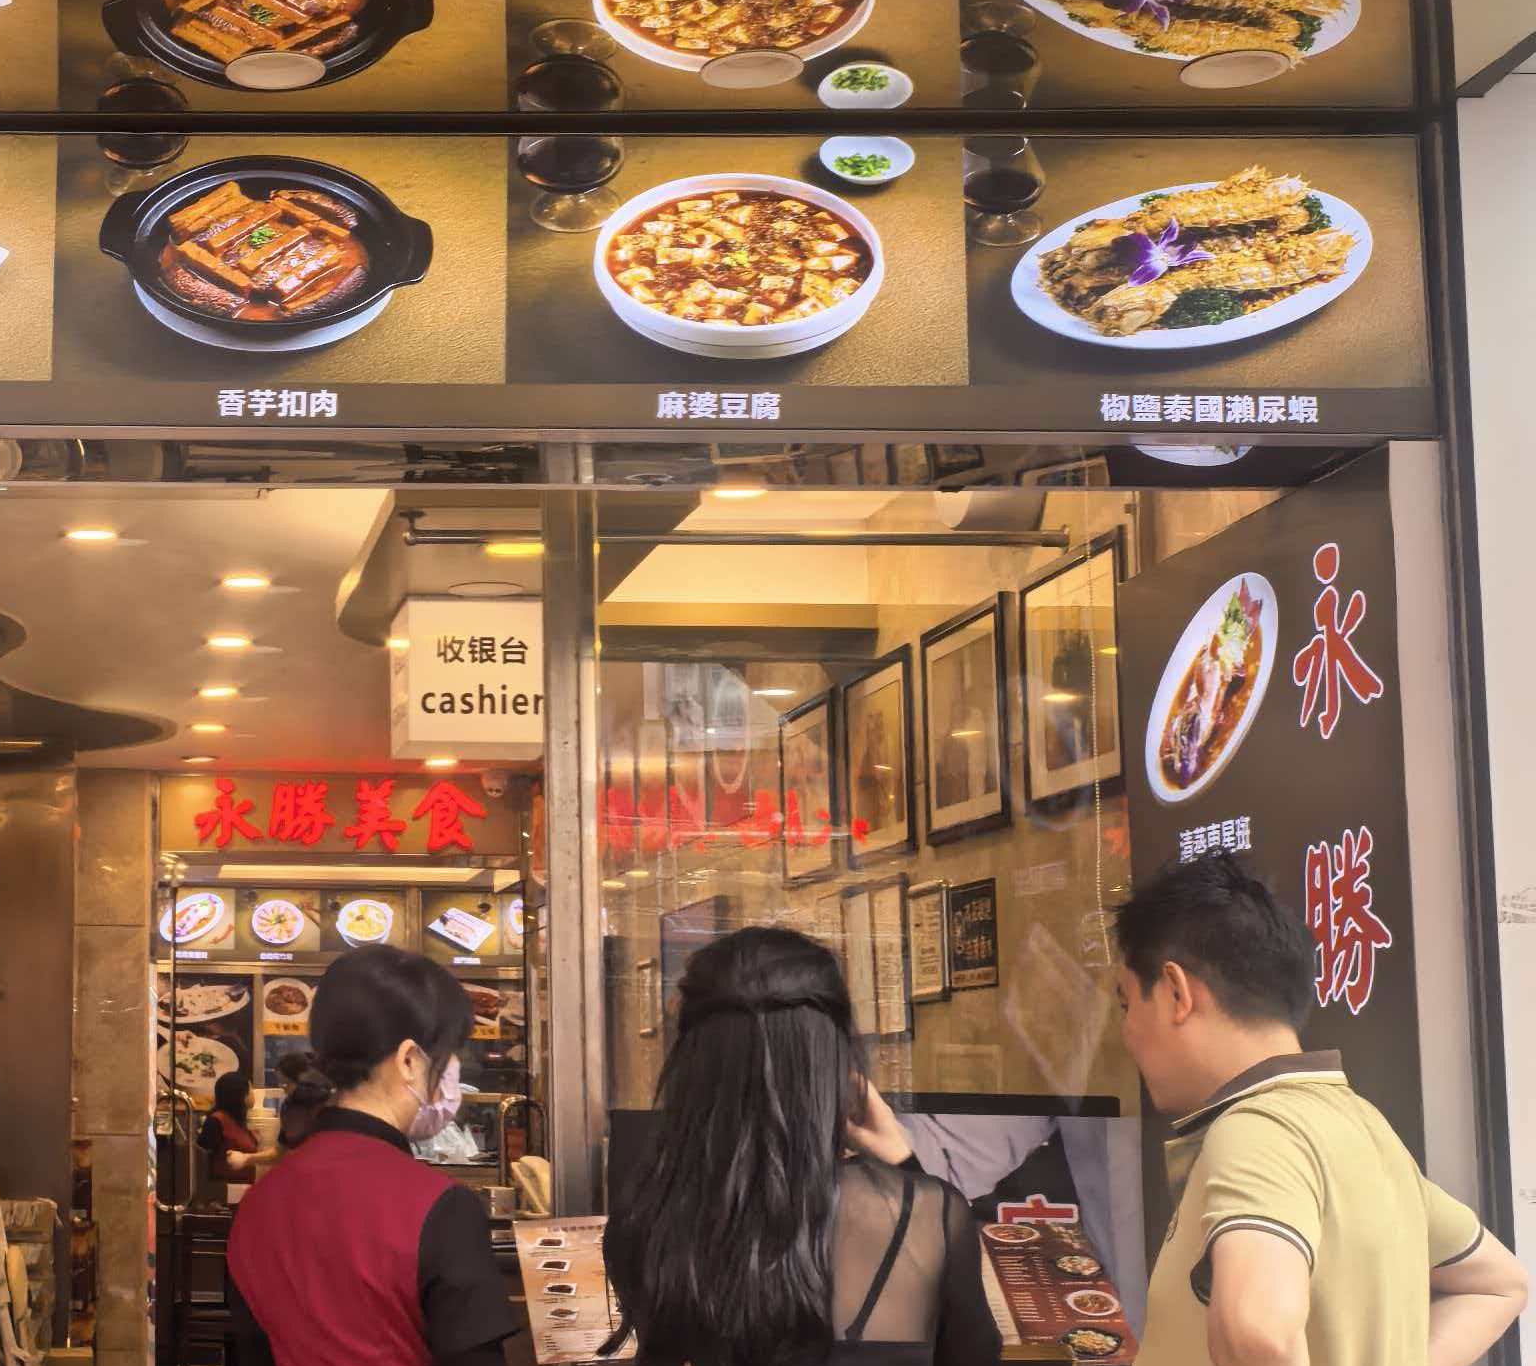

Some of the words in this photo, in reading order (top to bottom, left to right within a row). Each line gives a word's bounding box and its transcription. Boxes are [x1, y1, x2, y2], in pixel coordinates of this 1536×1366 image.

[217, 389, 338, 418] 香芋扣肉
[656, 392, 780, 421] 麻婆豆腐
[436, 636, 528, 665] 收银台
[421, 685, 543, 716] cashier
[1293, 542, 1393, 1016] 永勝
[194, 778, 487, 852] 永勝美食
